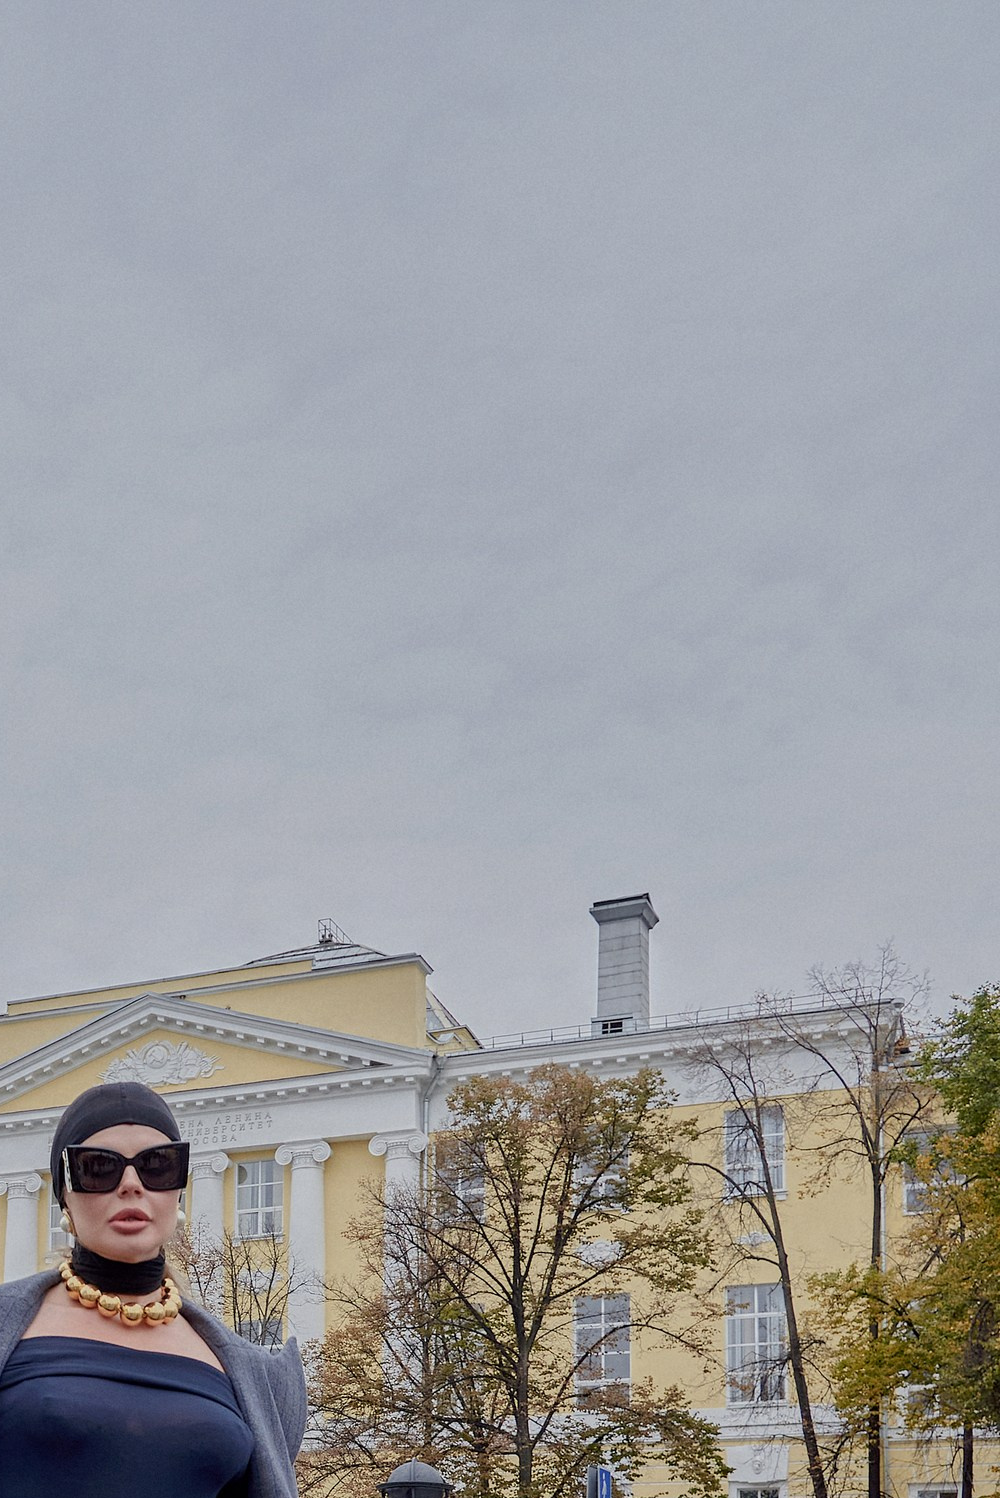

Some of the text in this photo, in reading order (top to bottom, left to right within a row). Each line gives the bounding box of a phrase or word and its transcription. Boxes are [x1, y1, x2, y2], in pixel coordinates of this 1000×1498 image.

[179, 1111, 272, 1130] ЕНА ЛЕНИНА
[180, 1119, 273, 1138] УНИВЕРСИТЕТ
